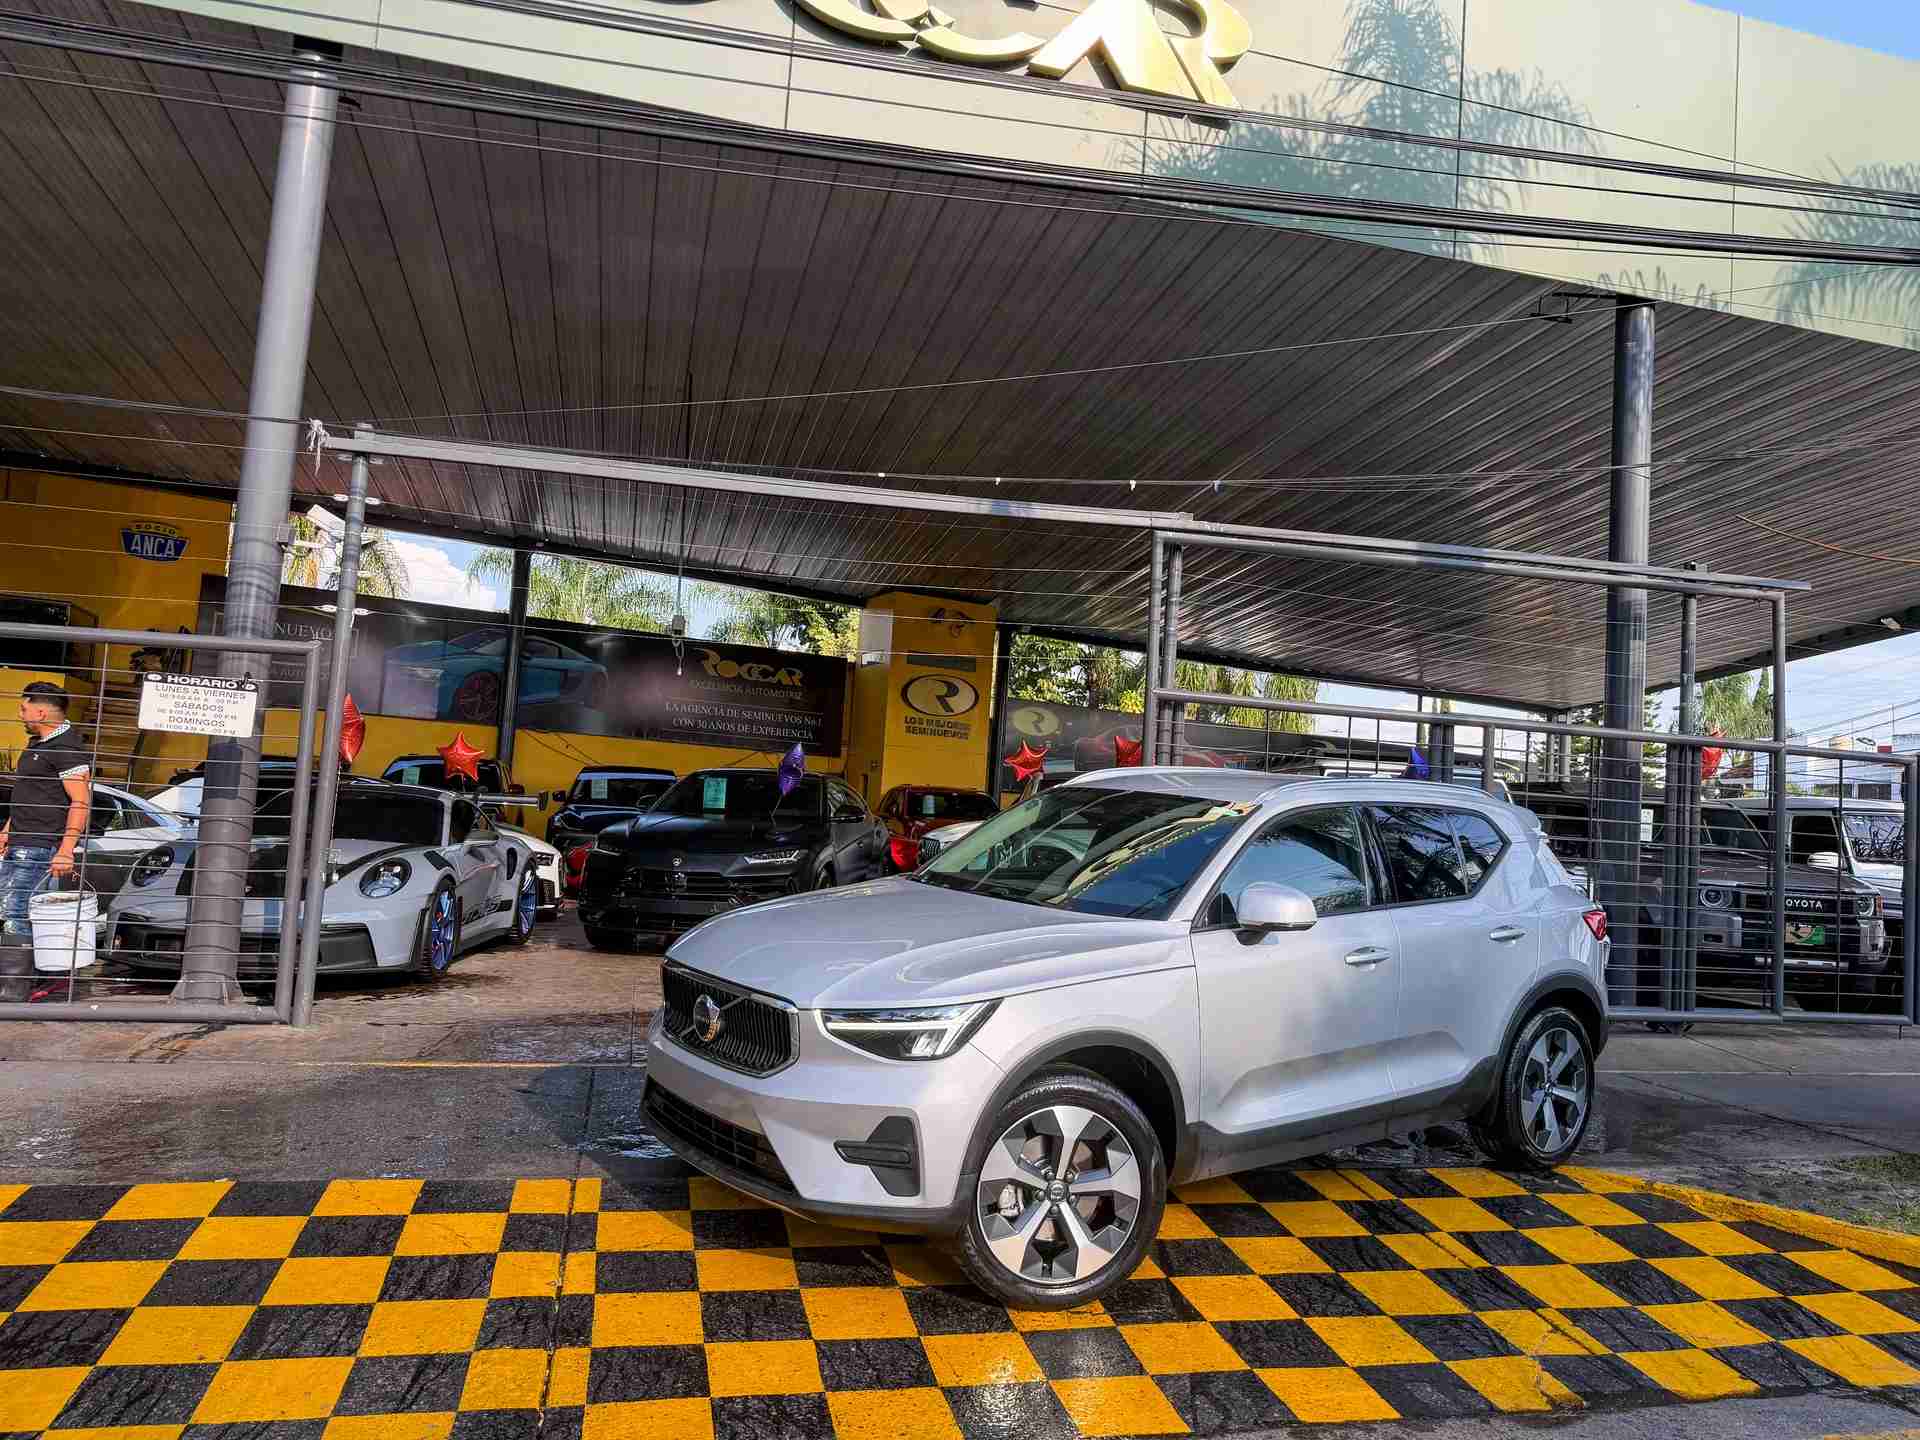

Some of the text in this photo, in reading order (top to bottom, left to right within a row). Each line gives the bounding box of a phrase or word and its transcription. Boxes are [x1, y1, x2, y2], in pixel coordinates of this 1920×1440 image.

[130, 534, 176, 558] ANCA
[167, 675, 238, 689] HORARIO
[155, 683, 190, 694] LUNES
[203, 689, 246, 700] VIERNES
[680, 703, 725, 717] AGENCIA
[727, 708, 741, 719] DE
[742, 710, 803, 724] SEMINUEVOS
[904, 715, 924, 726] LOS
[168, 715, 225, 728] DOMINGOS
[672, 717, 694, 729] CON
[737, 722, 751, 735] DE
[752, 724, 814, 741] EXPERIENCIA
[1785, 898, 1823, 911] OYOTA
